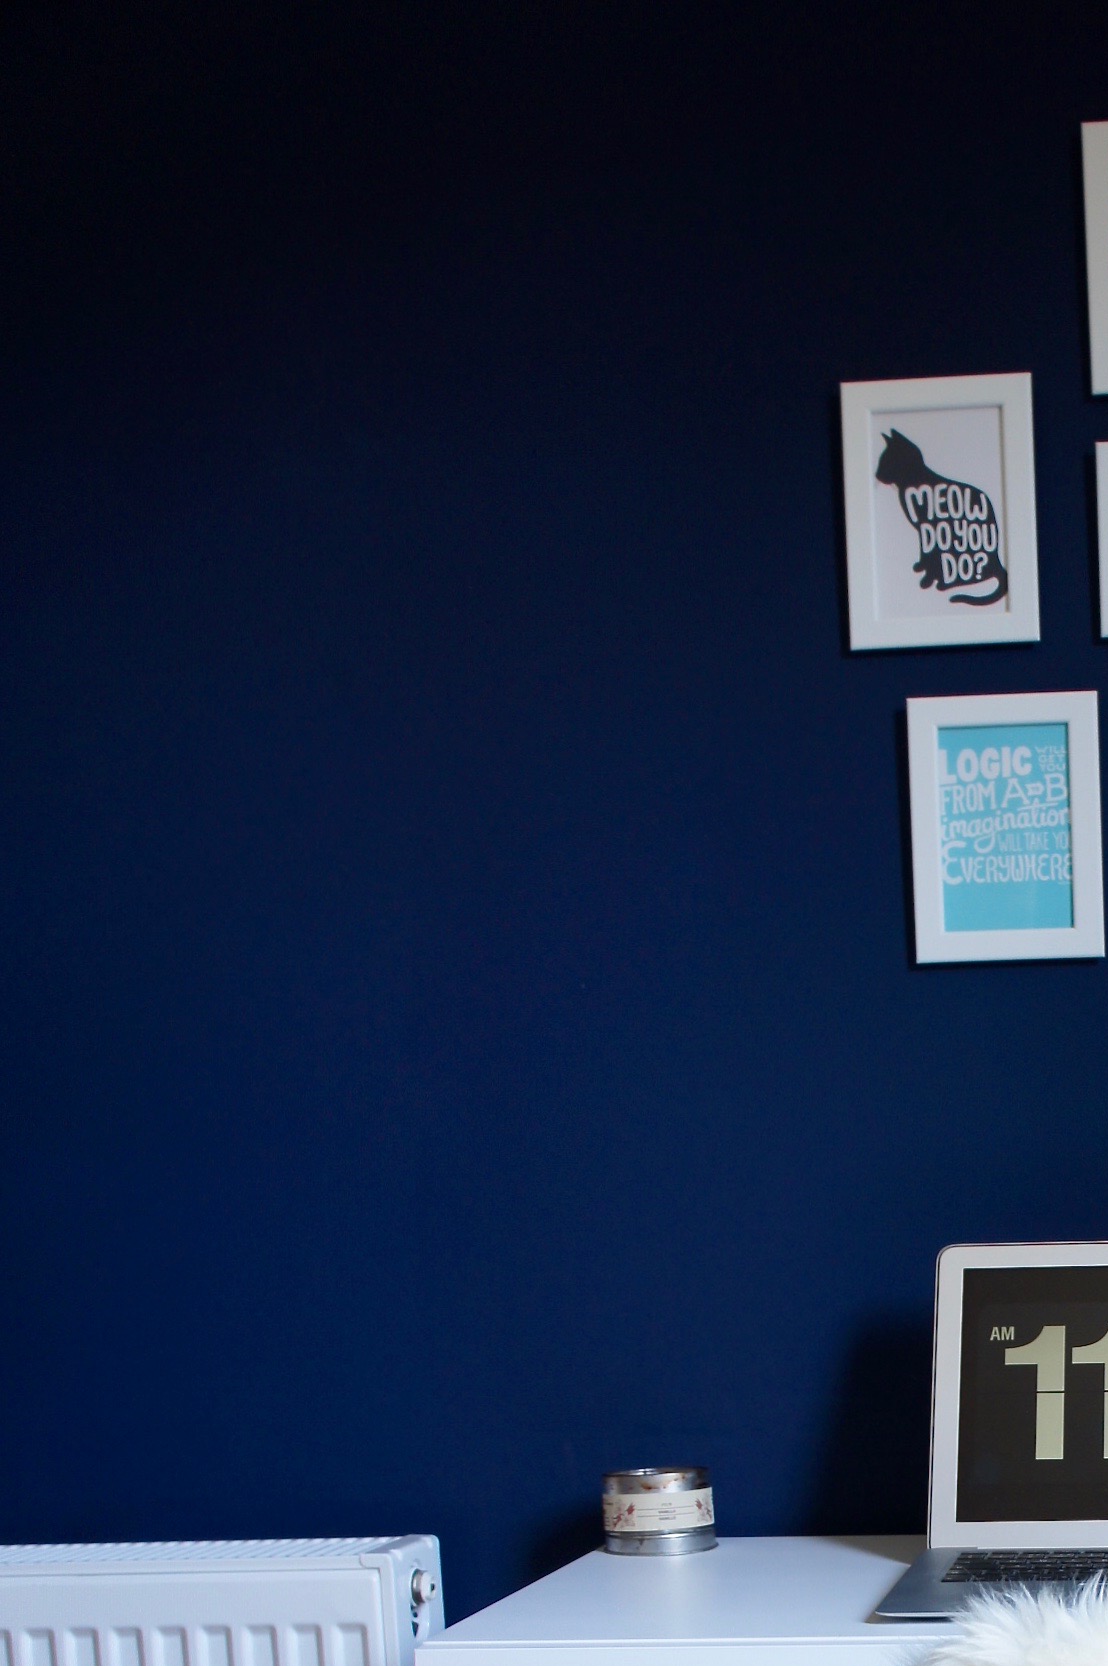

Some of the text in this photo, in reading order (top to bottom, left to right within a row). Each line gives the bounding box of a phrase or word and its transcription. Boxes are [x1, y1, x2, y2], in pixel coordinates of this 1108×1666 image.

[905, 484, 987, 523] MEOW
[920, 519, 997, 553] DO YOU
[941, 553, 988, 584] DO?
[939, 746, 1033, 783] LOGIC
[939, 772, 1068, 815] FROM A B
[998, 833, 1022, 853] WILL
[1024, 831, 1049, 851] TAKE
[990, 1326, 1014, 1341] AM
